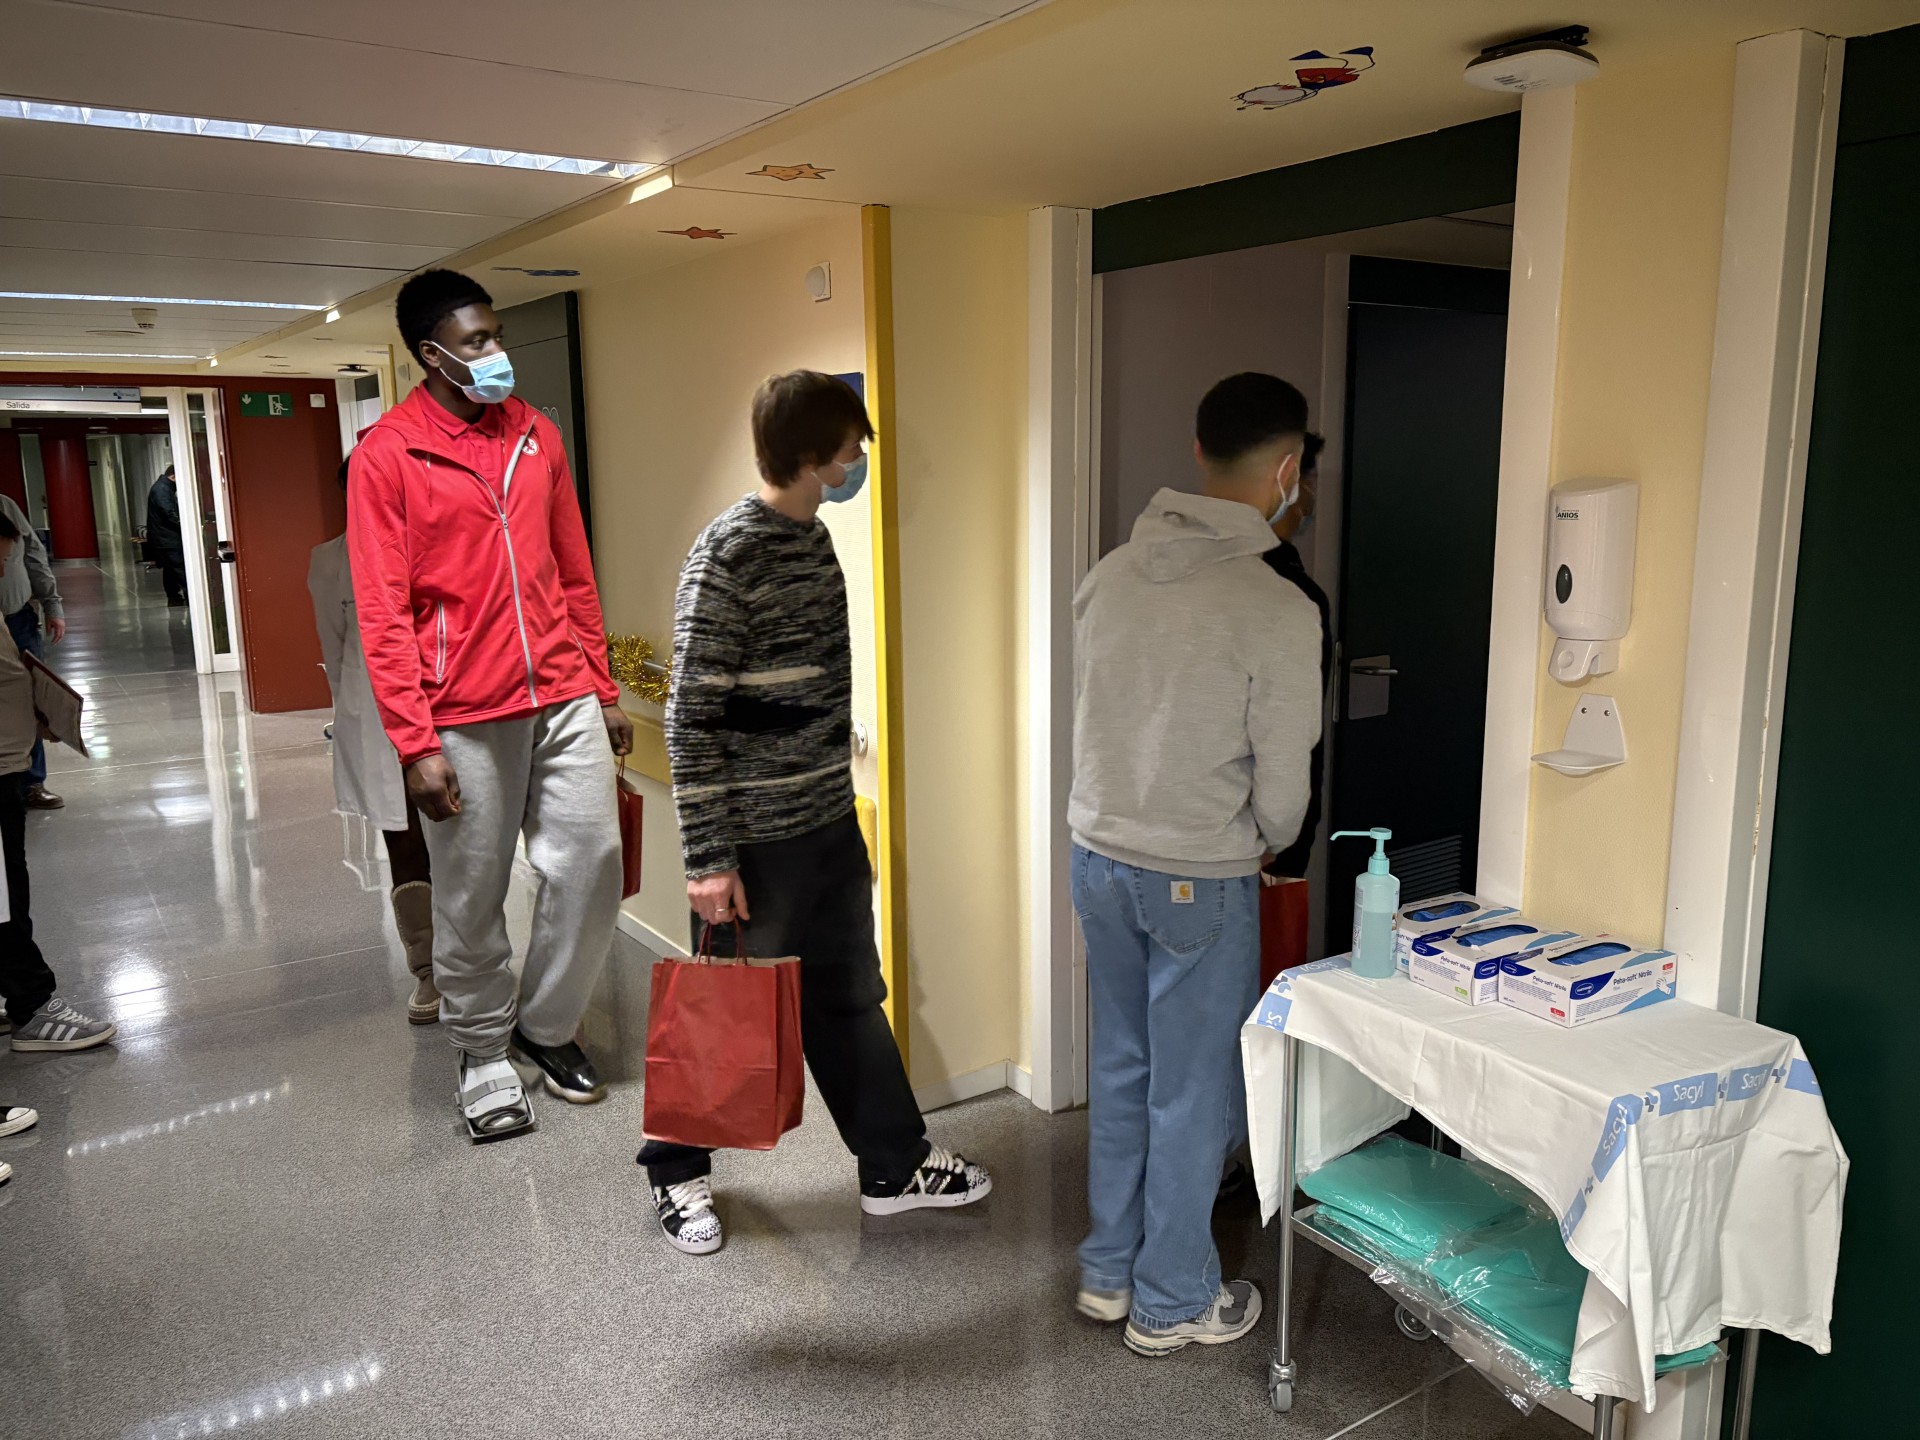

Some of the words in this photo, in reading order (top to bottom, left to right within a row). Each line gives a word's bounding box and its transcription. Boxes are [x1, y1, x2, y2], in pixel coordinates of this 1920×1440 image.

[6, 401, 31, 409] Salida
[1741, 1069, 1767, 1090] Sacyl
[1673, 1080, 1705, 1105] Sacyl
[1602, 1103, 1628, 1156] Sacyl
